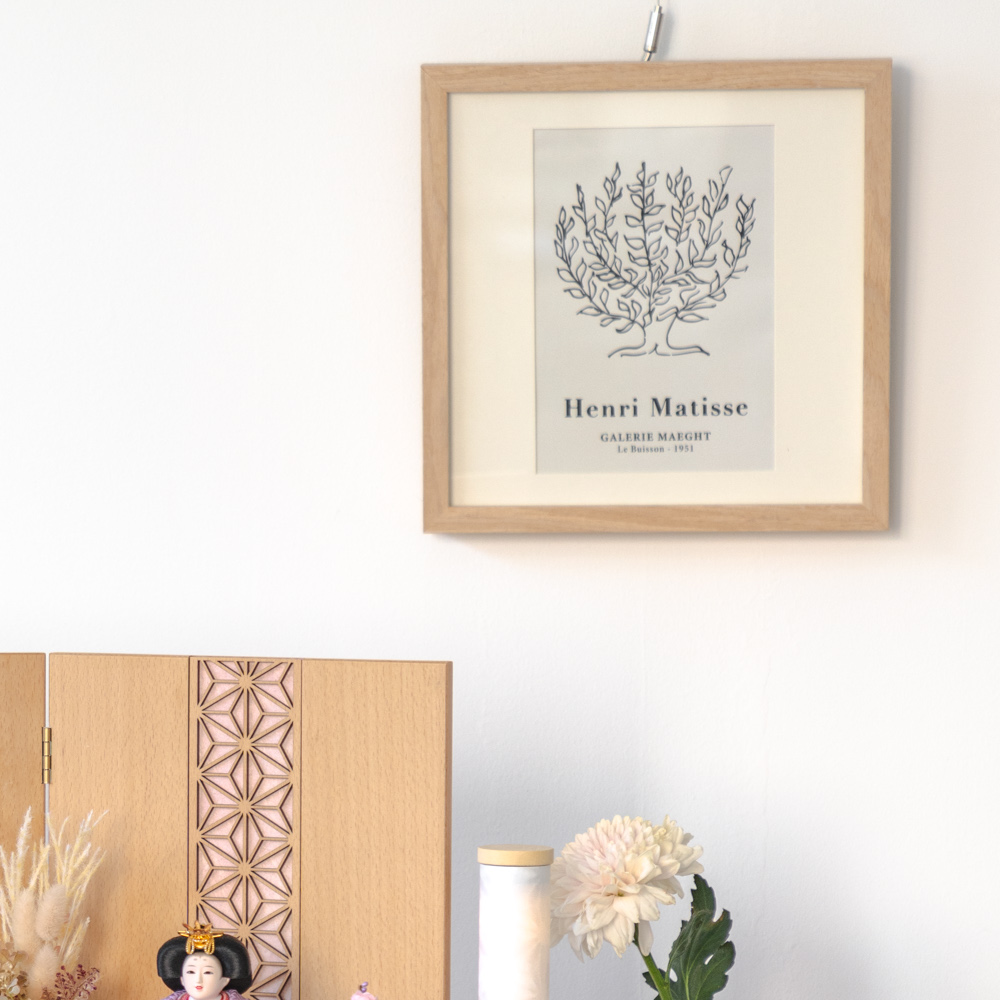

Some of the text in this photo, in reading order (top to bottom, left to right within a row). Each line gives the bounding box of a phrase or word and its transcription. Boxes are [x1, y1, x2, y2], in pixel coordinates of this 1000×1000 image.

[564, 397, 749, 418] Henri Matisse
[600, 431, 712, 442] GALERIE MAEGHT
[617, 445, 628, 453] Le
[631, 445, 665, 453] Buisson
[674, 444, 694, 453] 1951
